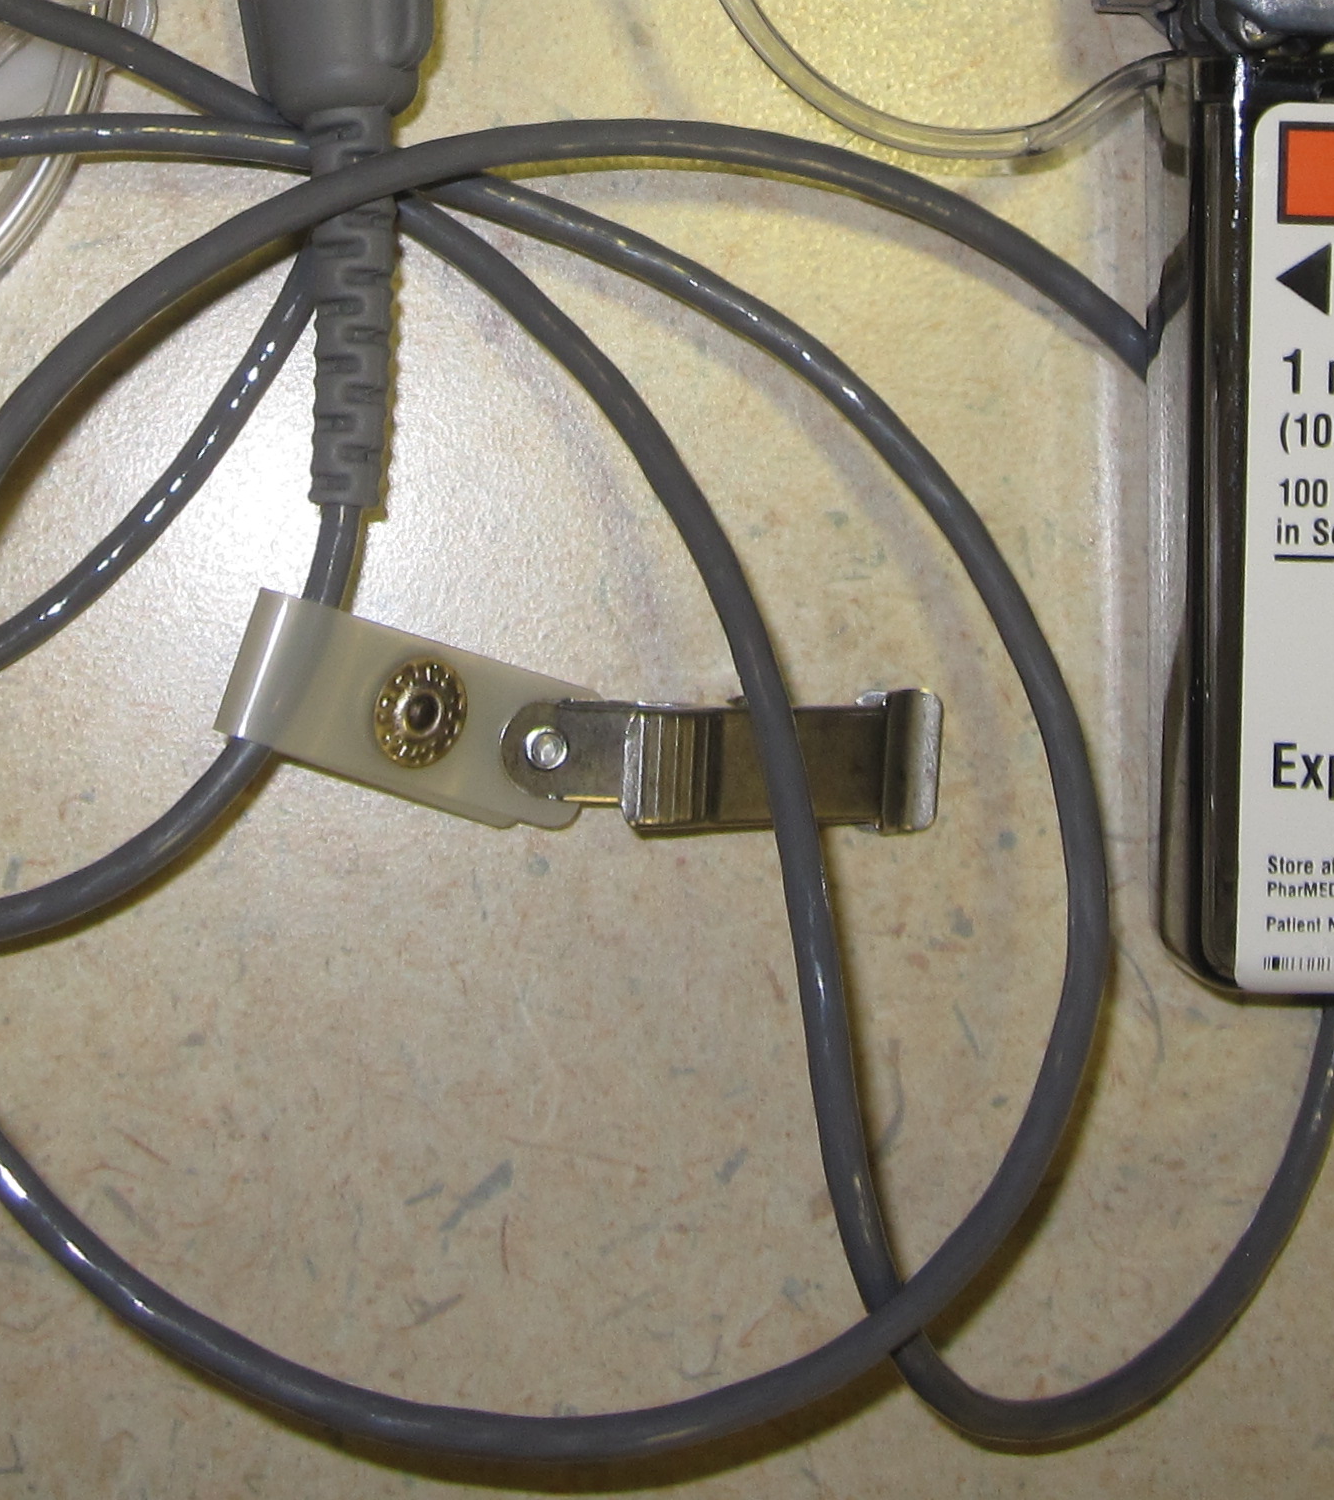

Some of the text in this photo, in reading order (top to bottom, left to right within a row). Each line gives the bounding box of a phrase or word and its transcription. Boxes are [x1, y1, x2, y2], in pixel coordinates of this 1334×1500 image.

[1282, 349, 1302, 394] 1
[1278, 478, 1329, 508] 100
[1275, 518, 1300, 545] in
[1267, 855, 1314, 875] Store
[1267, 916, 1321, 933] Patient
